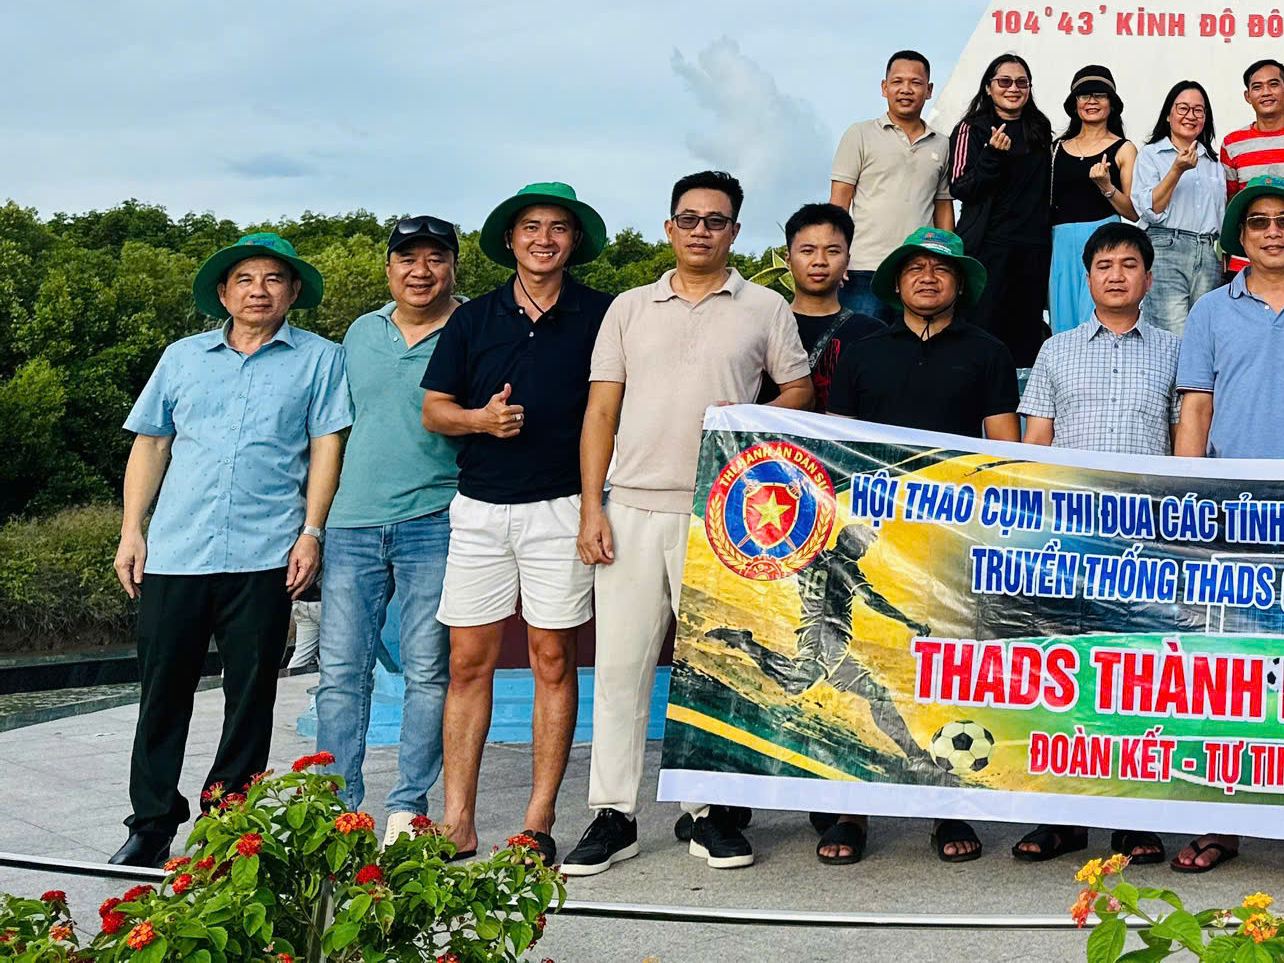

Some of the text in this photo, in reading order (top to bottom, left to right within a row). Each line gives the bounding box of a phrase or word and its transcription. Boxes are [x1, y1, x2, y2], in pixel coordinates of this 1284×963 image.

[1199, 8, 1236, 43] ĐỘ
[720, 465, 739, 487] THI
[852, 473, 899, 527] HỘI
[904, 482, 974, 523] THAO
[981, 488, 1043, 535] CỤM
[1051, 492, 1092, 534] THI
[1099, 494, 1154, 537] ĐUA
[1162, 494, 1217, 539] CÁC
[972, 541, 1077, 597] TRUYỀN
[1085, 545, 1177, 600] THỐNG
[1185, 563, 1274, 607] THADS
[914, 641, 1077, 708] THADS
[1094, 642, 1264, 719] THÀNH
[1029, 727, 1111, 778] ĐOÀN
[1121, 727, 1176, 781] KẾT
[1205, 740, 1244, 793] TỰ
